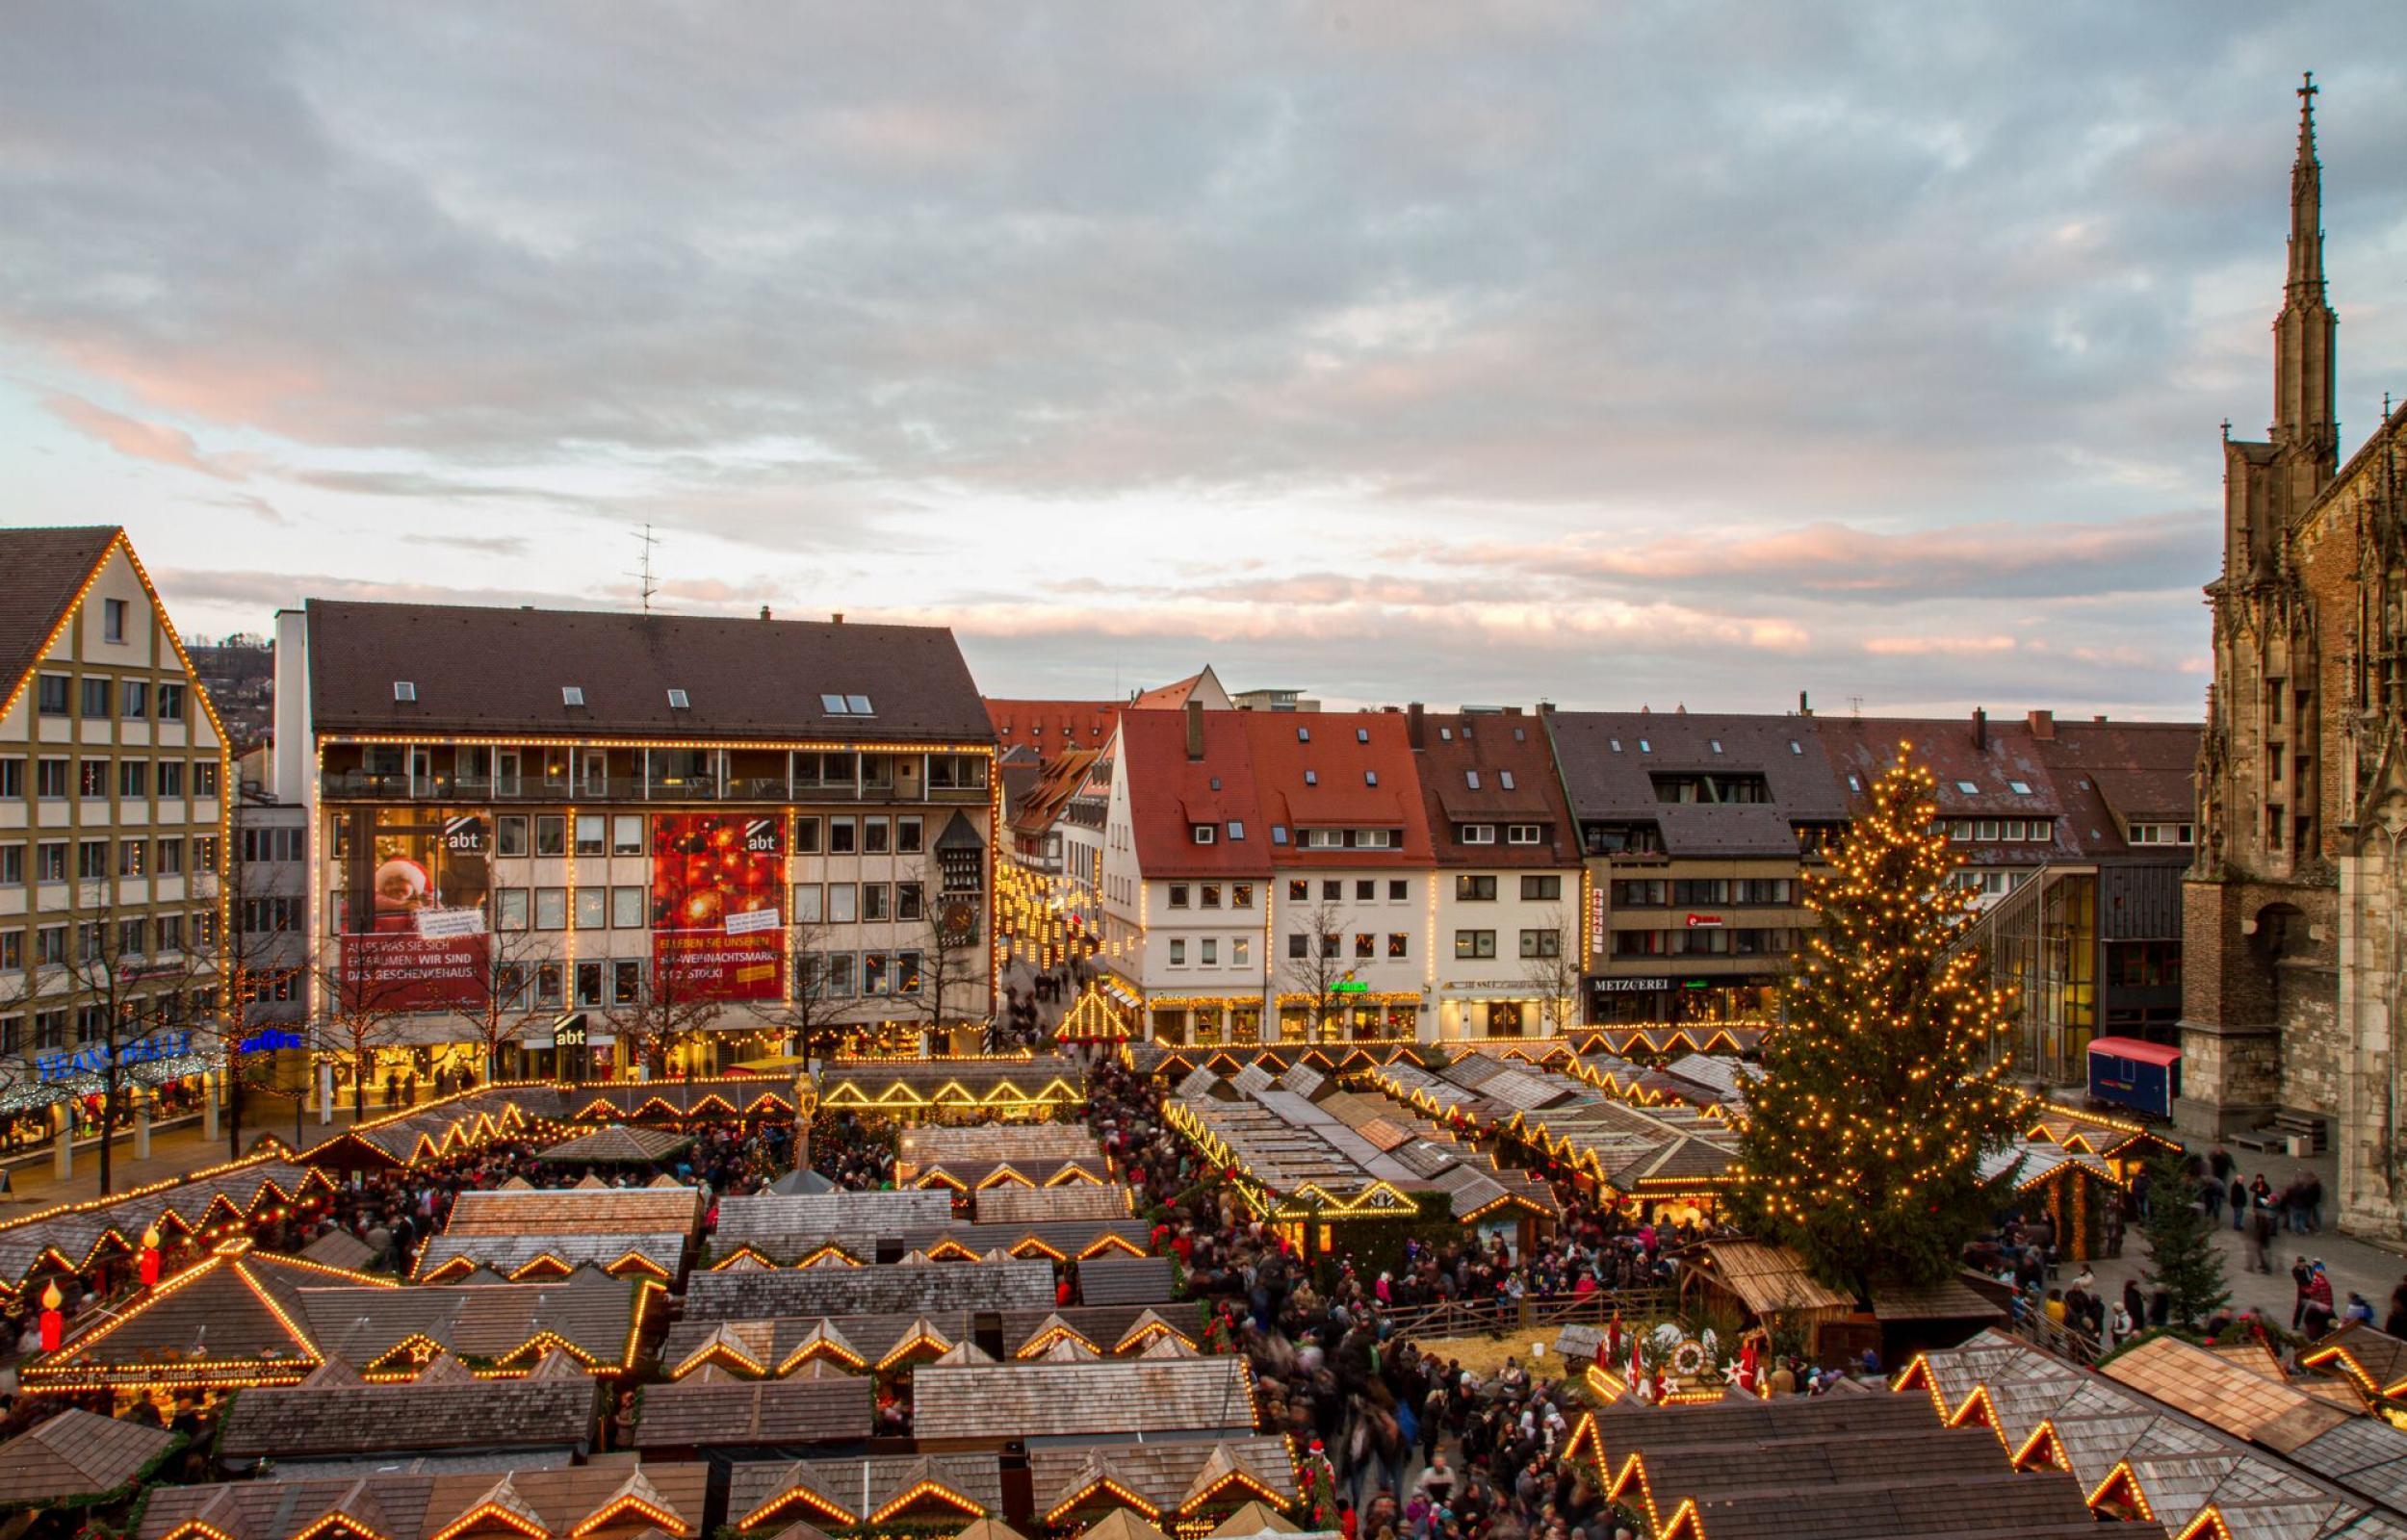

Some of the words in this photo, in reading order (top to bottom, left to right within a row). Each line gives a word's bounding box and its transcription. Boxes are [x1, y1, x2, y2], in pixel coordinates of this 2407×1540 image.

[449, 832, 479, 848] abt
[748, 834, 774, 850] abt
[407, 941, 423, 951] SIE
[426, 940, 450, 951] SICH
[418, 954, 442, 964] WIR
[445, 953, 472, 964] SIND
[1594, 979, 1668, 991] METZGEREI
[556, 1029, 585, 1045] abt
